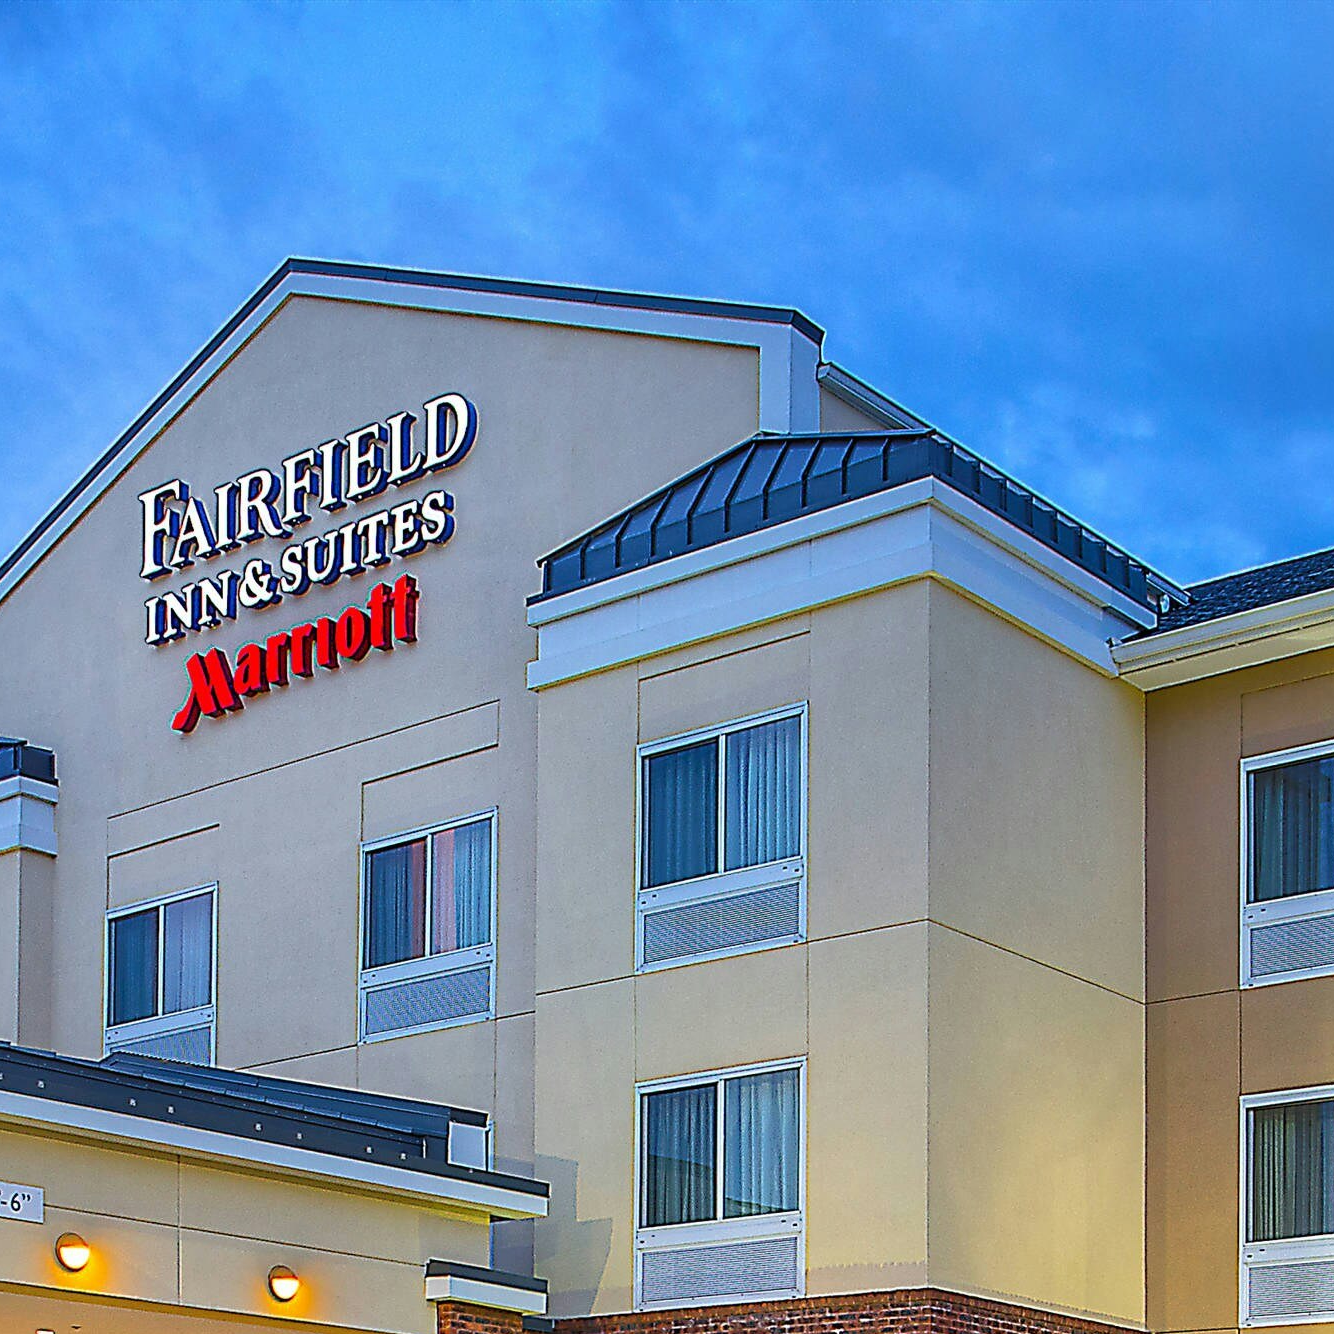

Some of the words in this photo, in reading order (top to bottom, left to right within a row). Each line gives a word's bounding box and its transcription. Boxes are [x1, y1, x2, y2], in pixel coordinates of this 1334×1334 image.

[139, 392, 478, 582] FAIRFIELD
[145, 570, 240, 647] INN
[239, 559, 283, 610] &
[280, 490, 457, 596] SUITES
[171, 573, 420, 733] Marriott
